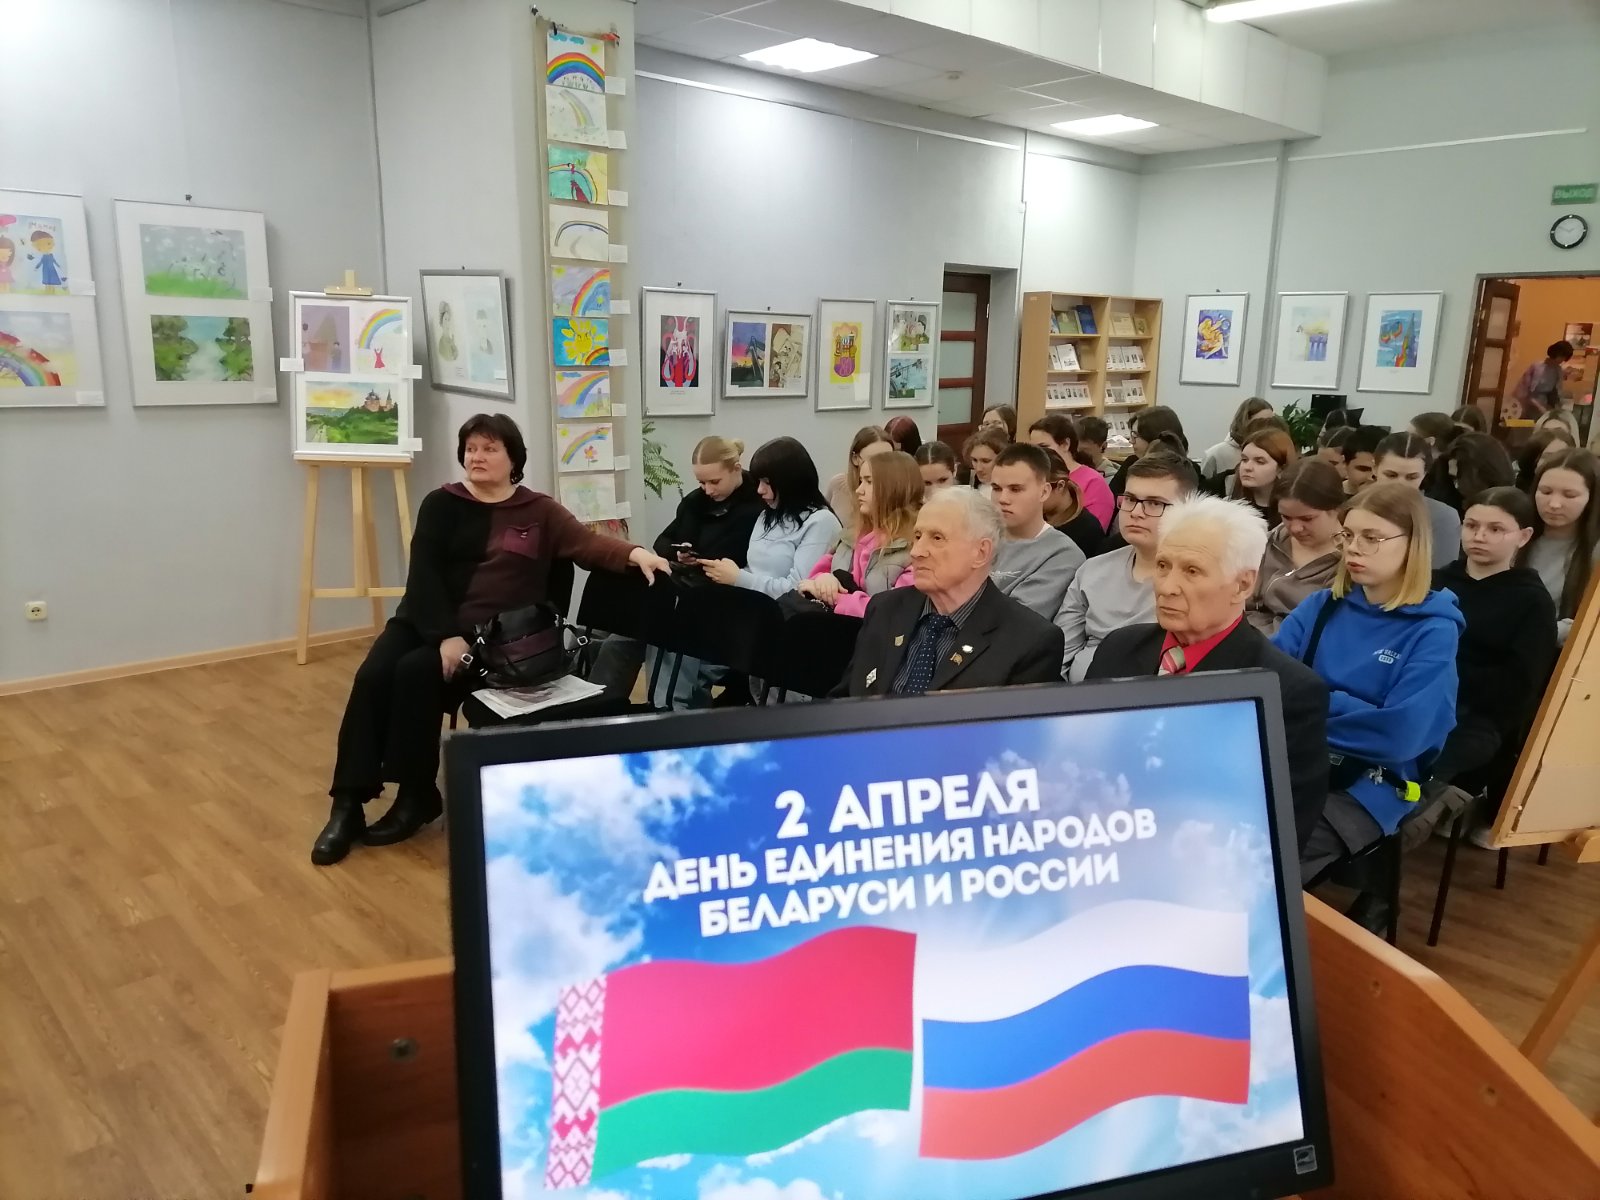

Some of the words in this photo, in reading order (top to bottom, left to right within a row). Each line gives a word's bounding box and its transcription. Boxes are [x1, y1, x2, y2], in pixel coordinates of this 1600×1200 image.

[775, 789, 809, 839] 2
[829, 768, 1040, 833] АПРЕЛЯ
[643, 853, 758, 904] ДЕНЬ
[765, 827, 976, 886] ЕДИНЕНИЯ
[982, 808, 1157, 858] НАРОДОВ
[699, 875, 916, 937] БЕЛАРУСИ
[924, 871, 953, 907] И
[960, 851, 1120, 902] РОССИИ
